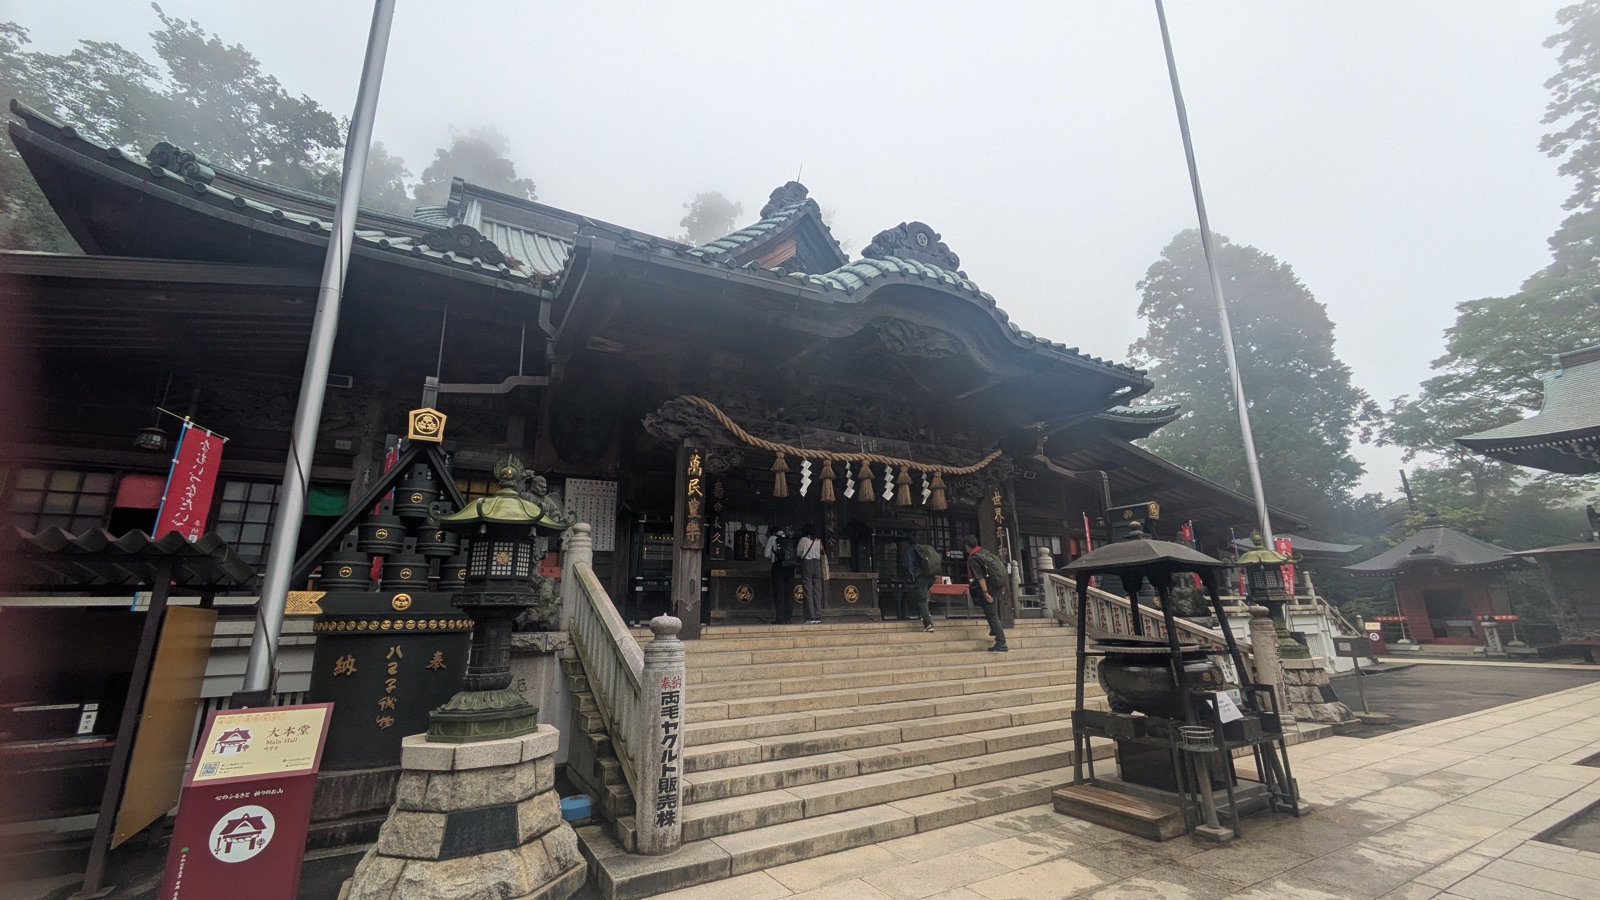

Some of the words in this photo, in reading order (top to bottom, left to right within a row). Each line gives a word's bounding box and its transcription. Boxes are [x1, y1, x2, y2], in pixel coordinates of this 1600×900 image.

[1098, 601, 1107, 628] ヤクルト
[1113, 607, 1122, 634] ヤクルト
[332, 655, 358, 677] 納
[425, 650, 447, 671] 奉
[660, 675, 682, 690] 奉納
[265, 724, 311, 739] 大本堂
